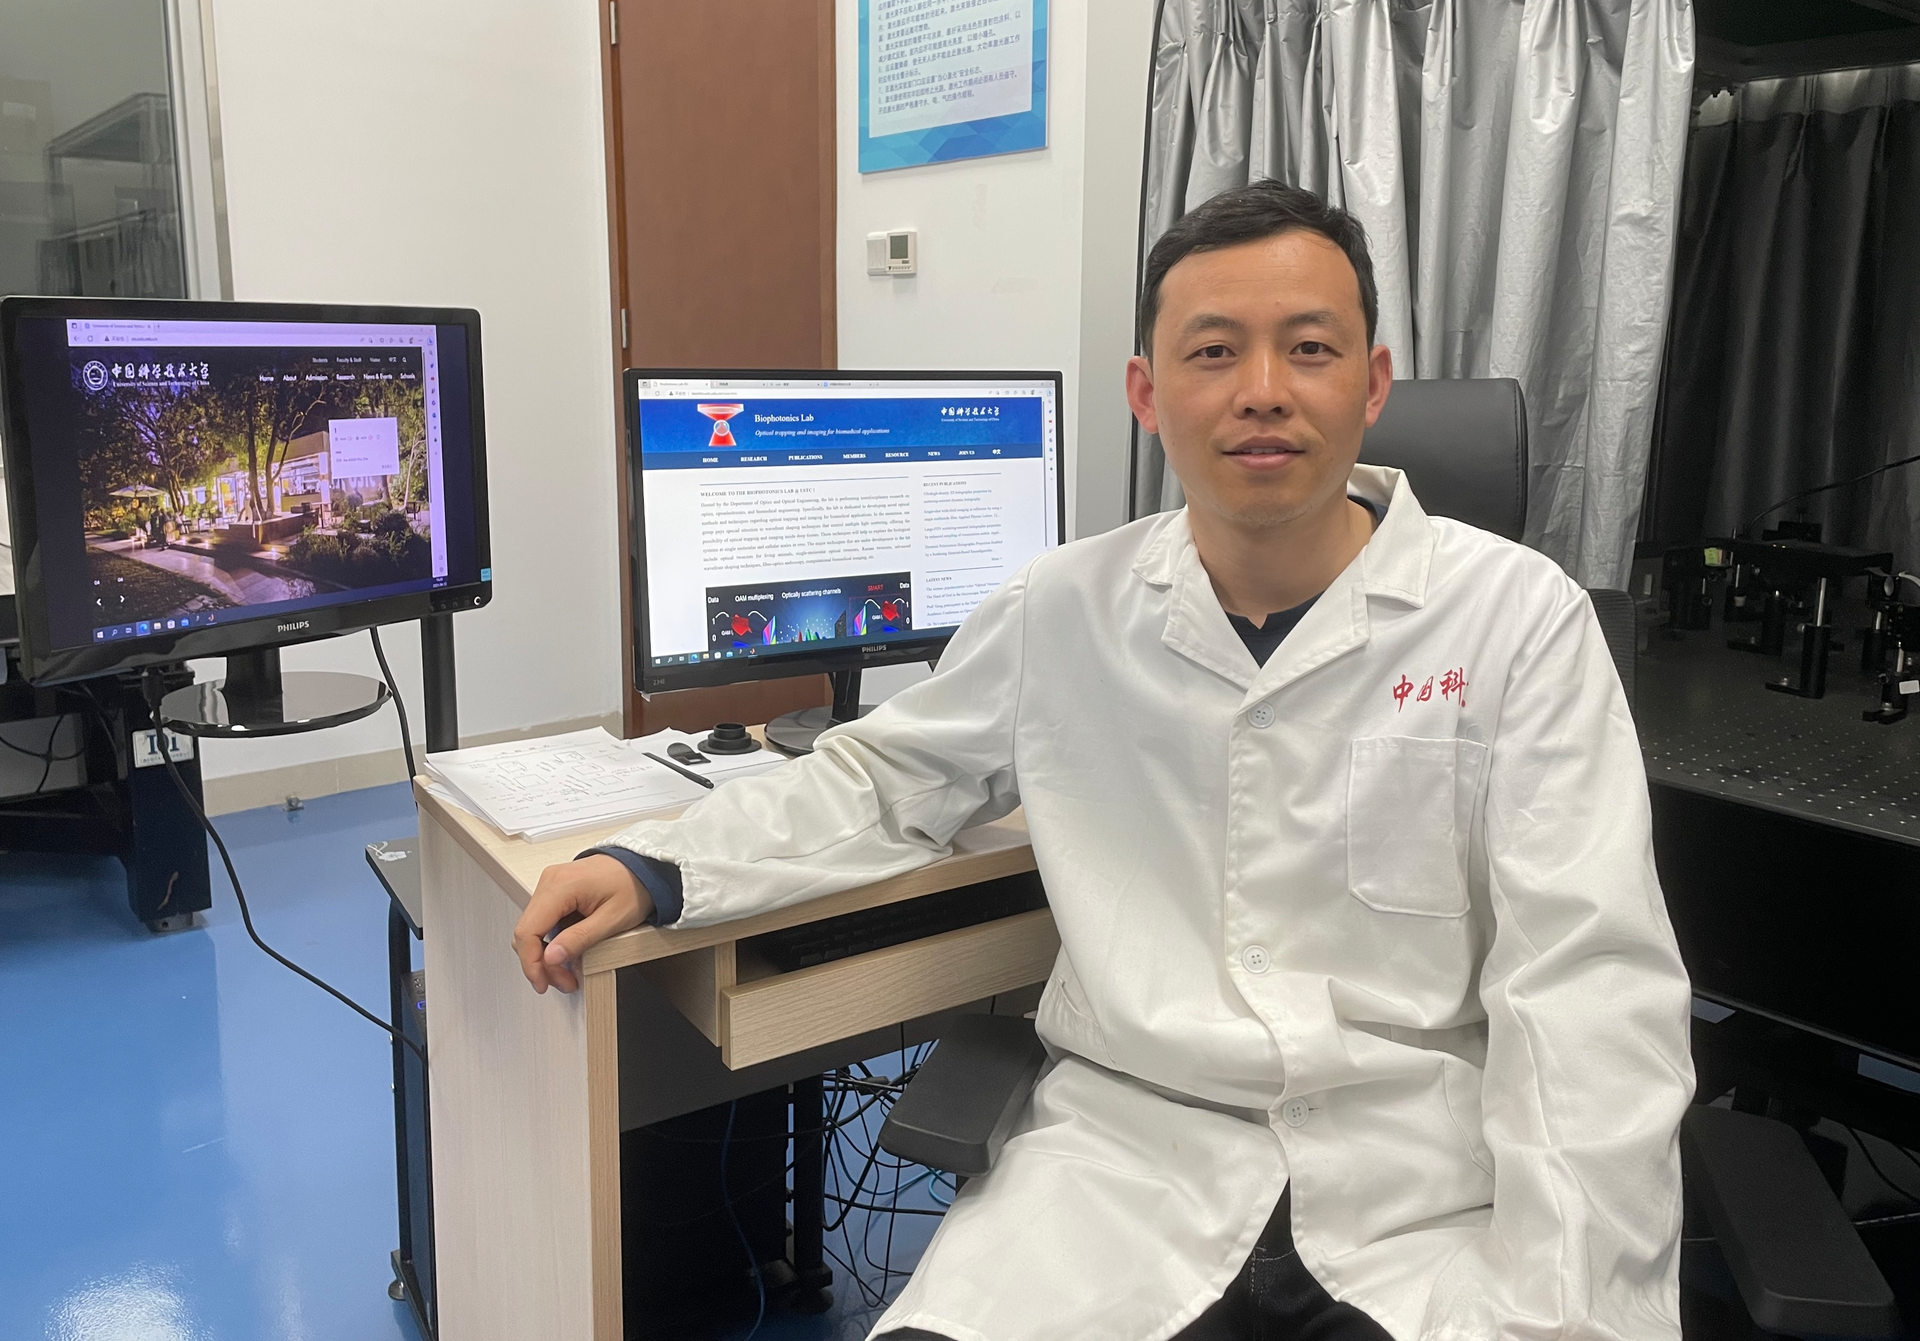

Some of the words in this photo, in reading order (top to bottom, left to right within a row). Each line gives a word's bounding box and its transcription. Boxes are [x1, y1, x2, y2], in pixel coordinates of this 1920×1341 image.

[112, 362, 209, 380] 中国科学技术大学
[941, 406, 1000, 417] 中国科学技术大学
[755, 414, 799, 424] Biophotonics
[801, 414, 814, 422] Lab
[826, 428, 834, 436] for
[748, 592, 774, 602] multiplexing
[781, 591, 801, 599] Optically
[801, 589, 822, 598] scattering
[823, 587, 841, 596] channels
[708, 596, 719, 604] Data
[277, 621, 310, 632] PHILIPS
[712, 634, 716, 642] 0
[862, 644, 887, 653] PHILIPS
